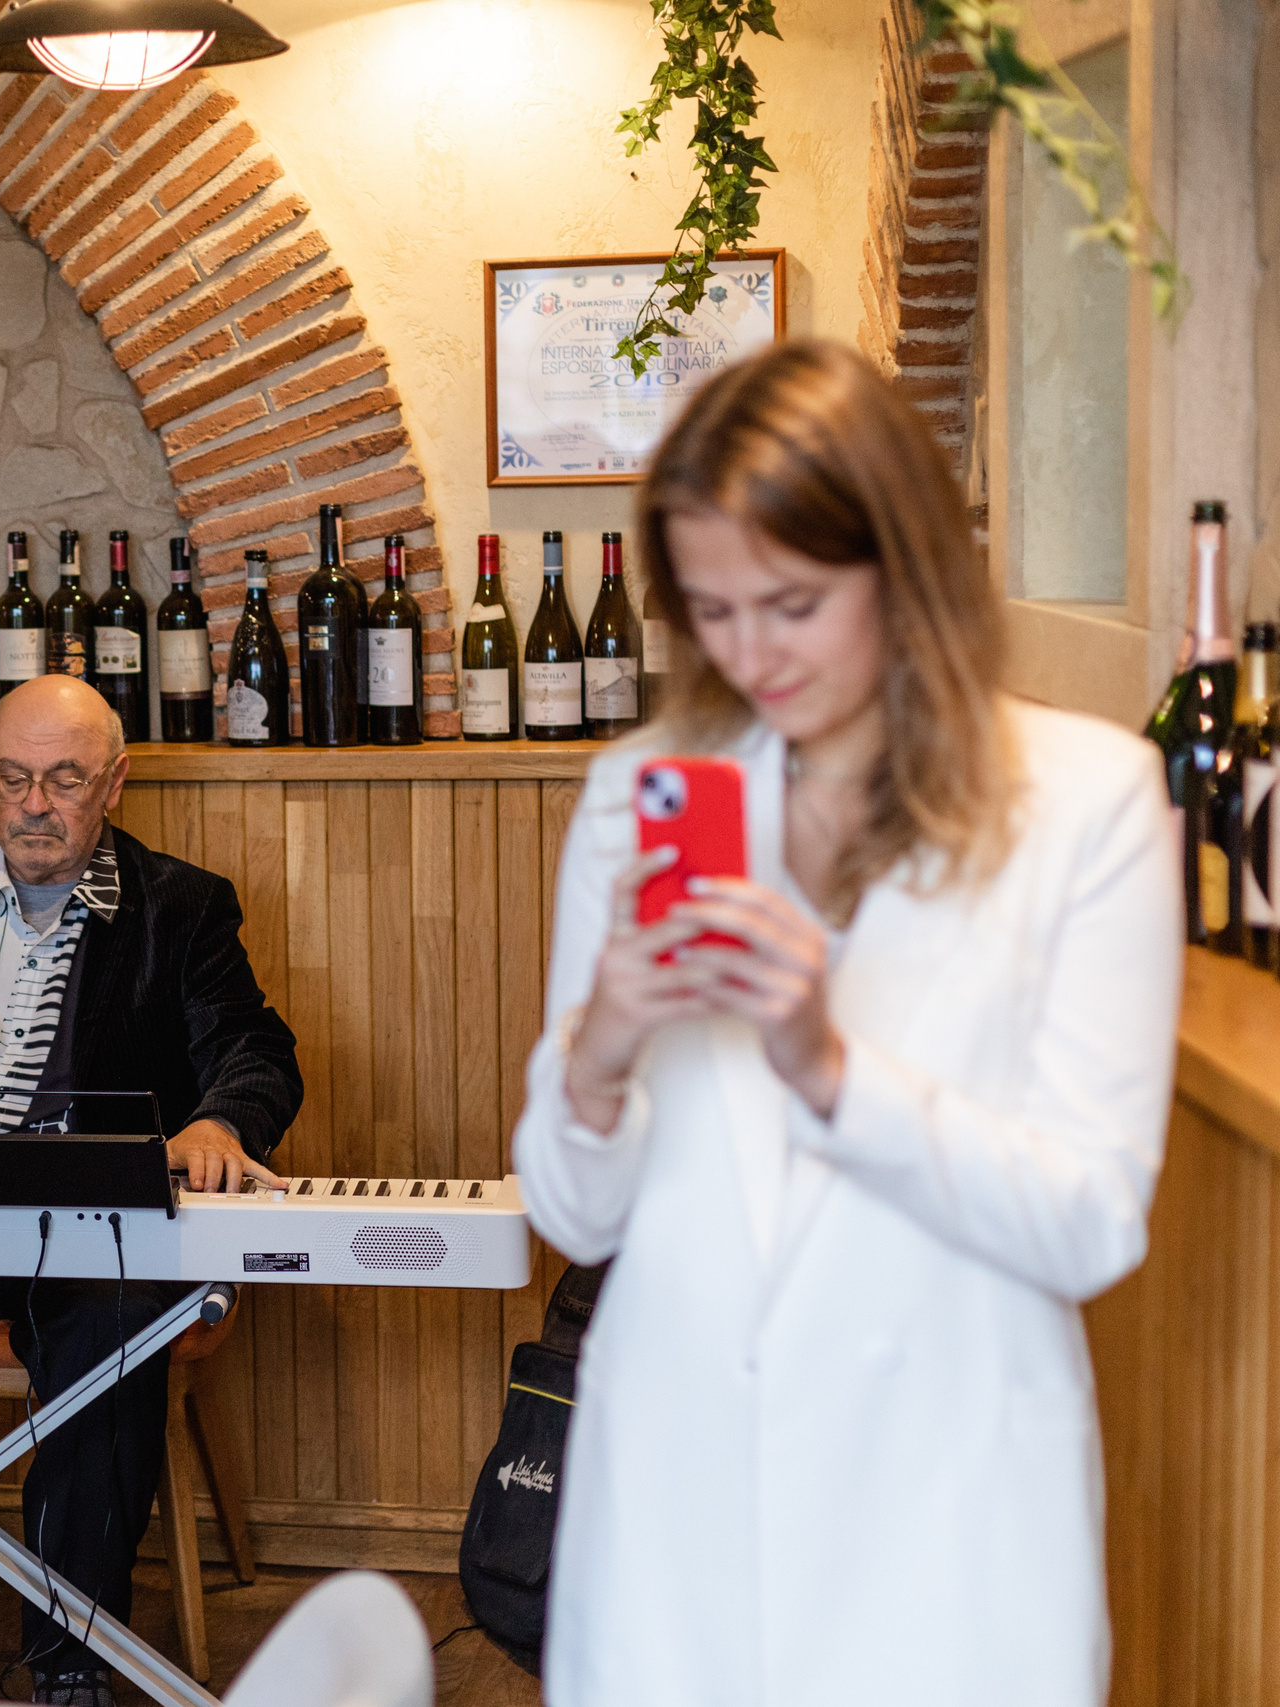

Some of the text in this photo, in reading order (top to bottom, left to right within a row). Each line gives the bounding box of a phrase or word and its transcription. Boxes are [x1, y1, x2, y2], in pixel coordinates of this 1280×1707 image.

[626, 298, 666, 306] ITALINA
[541, 340, 728, 360] INTERNAZII D'ITALIA
[541, 358, 632, 375] ESPOSIZION
[589, 372, 681, 388] 2010
